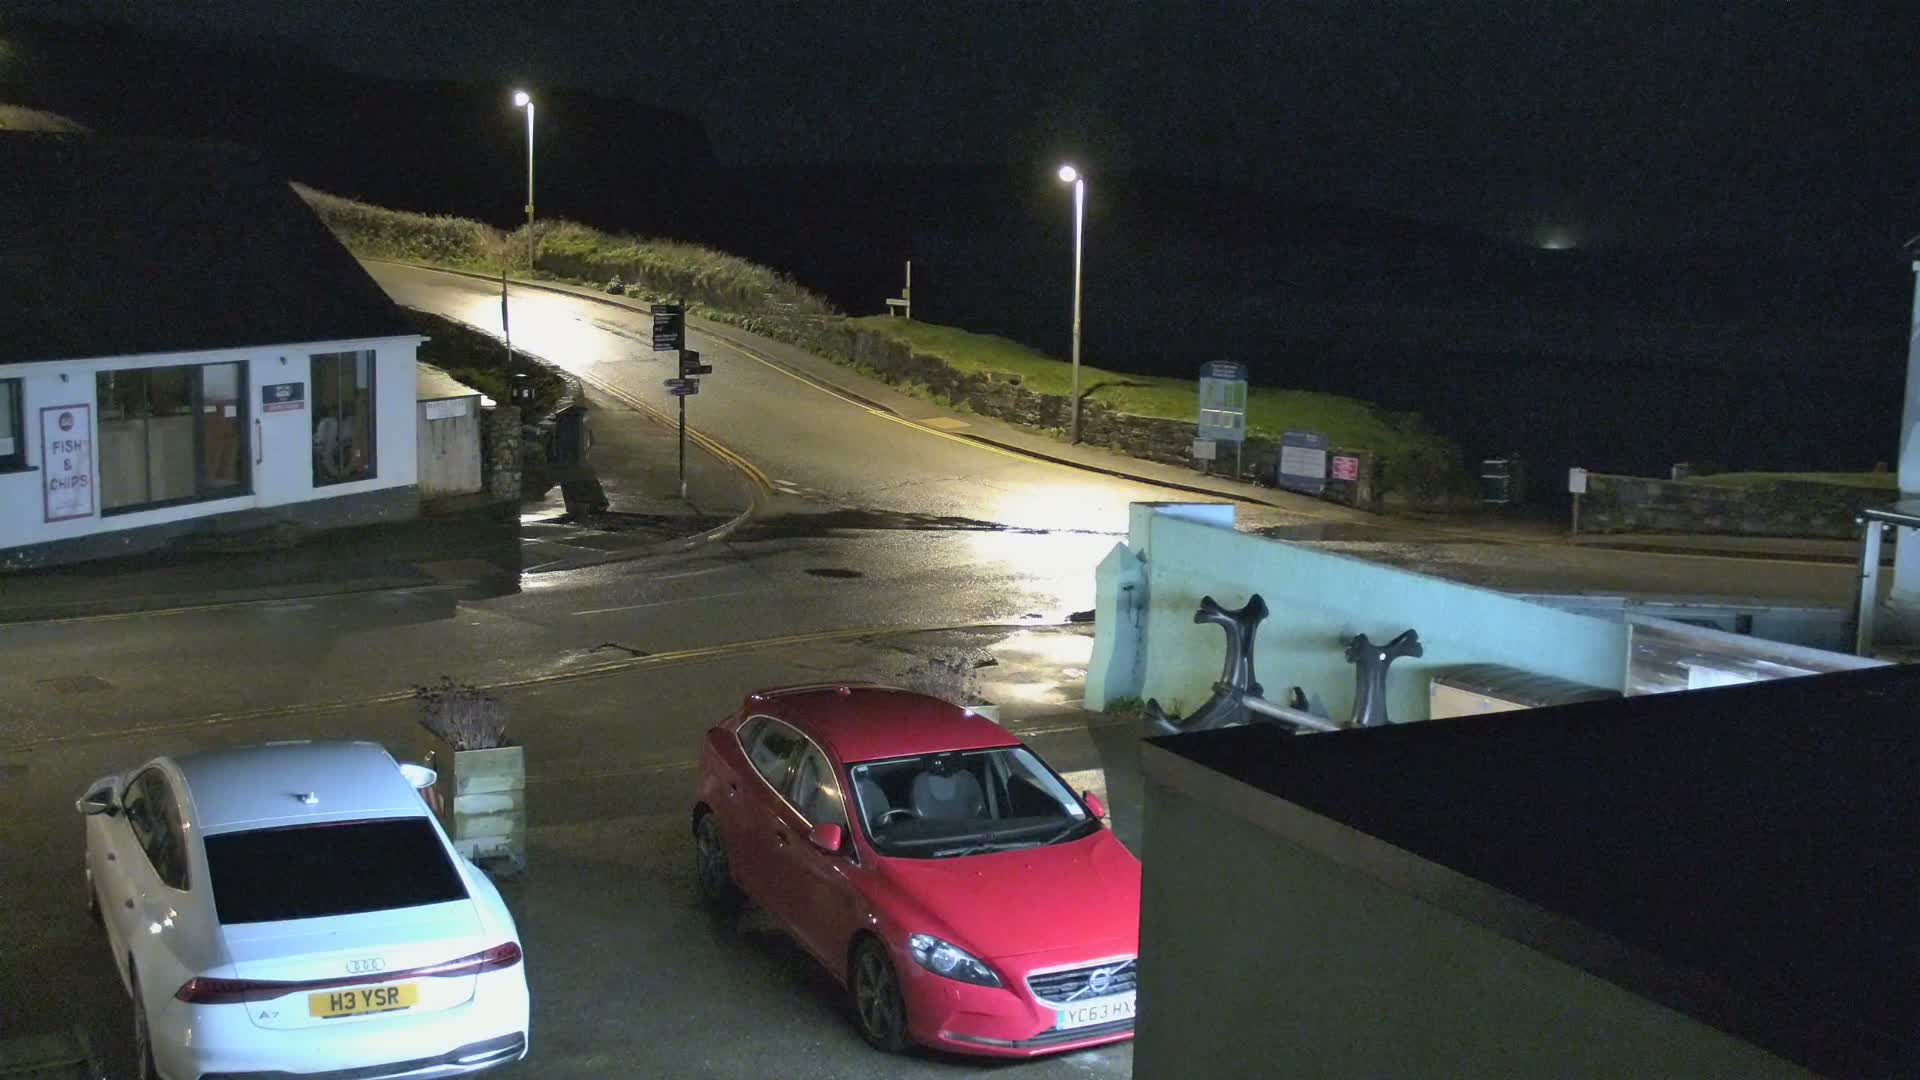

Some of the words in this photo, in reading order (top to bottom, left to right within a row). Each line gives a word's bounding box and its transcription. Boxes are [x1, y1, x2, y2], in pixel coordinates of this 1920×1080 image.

[52, 440, 82, 456] FISH
[63, 458, 73, 471] &
[49, 474, 89, 491] CHIPS
[330, 992, 356, 1012] H3
[362, 987, 399, 1007] YSR
[258, 1010, 280, 1020] A7
[1068, 1004, 1108, 1024] YC63
[1112, 998, 1136, 1016] HX
